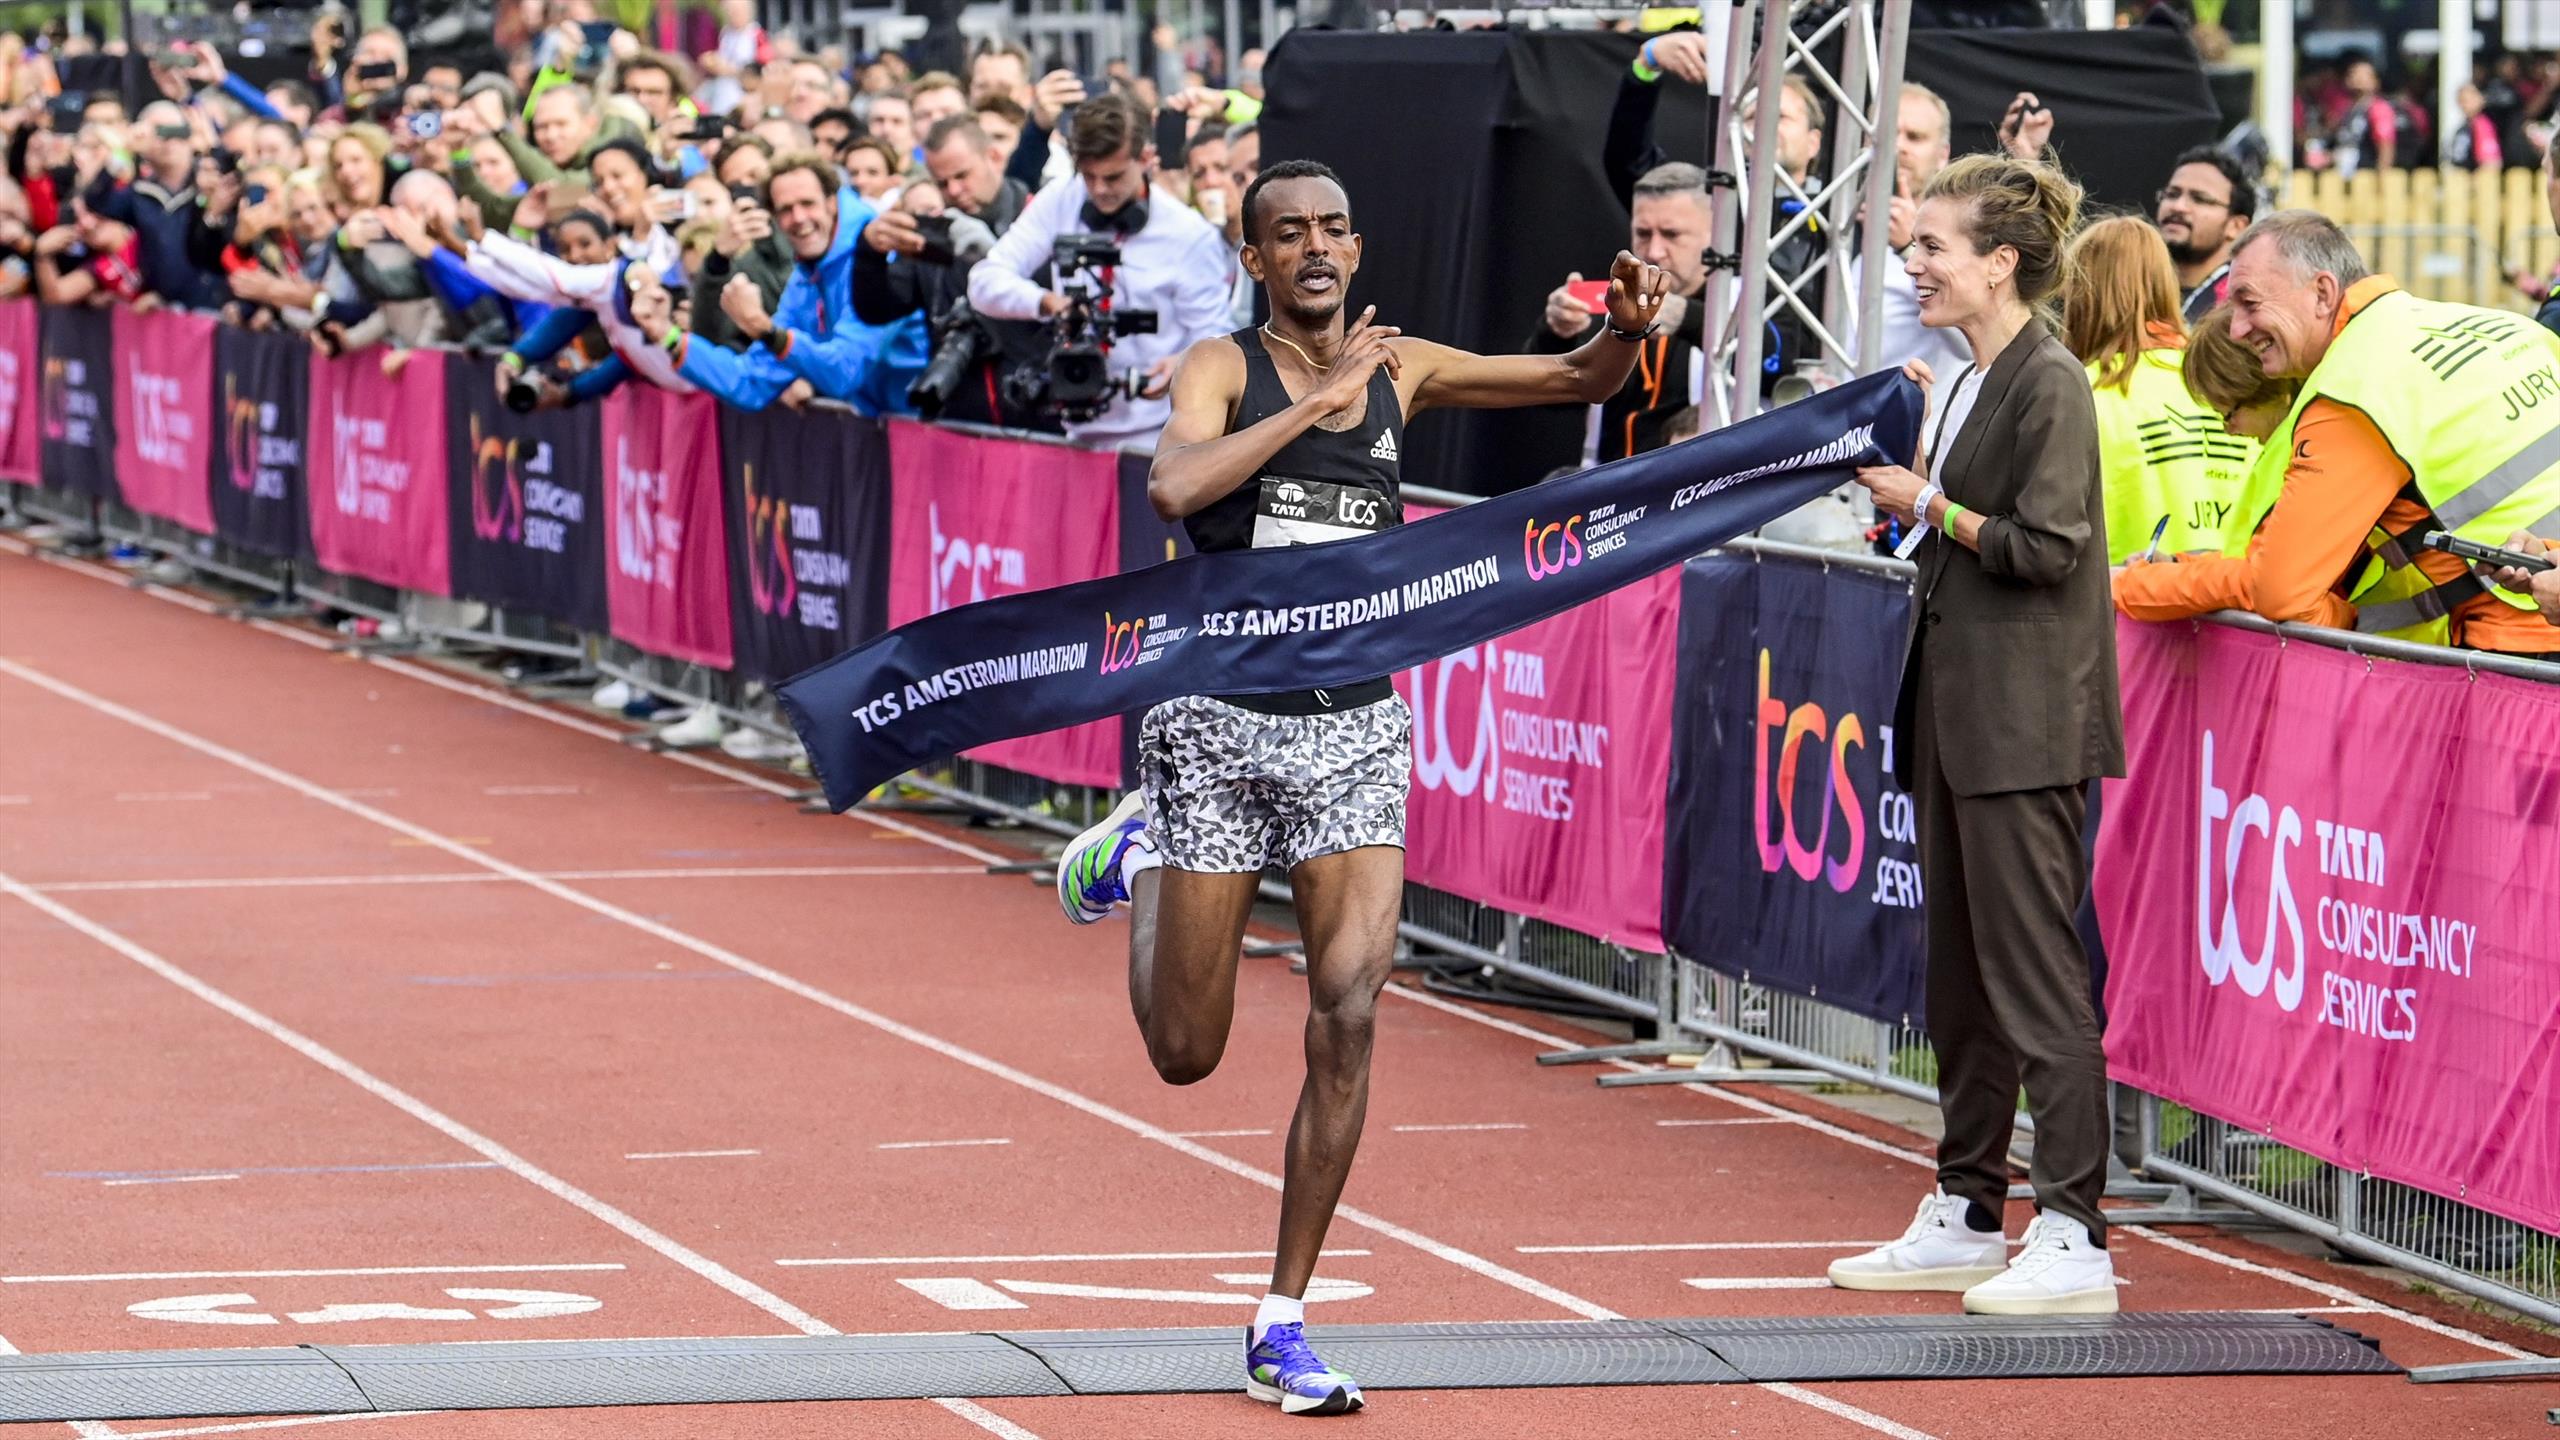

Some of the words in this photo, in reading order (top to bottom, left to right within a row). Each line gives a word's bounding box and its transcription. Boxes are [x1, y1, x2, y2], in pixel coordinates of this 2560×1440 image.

[2502, 364, 2560, 421] JURY
[1370, 447, 1398, 462] adidas
[1670, 482, 1702, 511] TCS
[1799, 422, 1874, 468] MARATHON
[1270, 502, 1306, 518] TATA
[1338, 491, 1379, 526] tcs
[1584, 505, 1648, 541] CONSULTANCY
[1588, 503, 1617, 523] TATA
[2188, 501, 2232, 529] JRY
[1524, 514, 1582, 581] tcs
[1587, 531, 1627, 560] SERVICES
[1148, 613, 1167, 631] TATA
[1241, 588, 1399, 636] AMSTERDAM
[1402, 555, 1500, 613] MARATHON
[1100, 611, 1145, 675] tcs
[1143, 626, 1188, 648] CONSULTANCY
[852, 693, 901, 733] TCS
[904, 654, 1018, 711] AMSTERDAM
[1020, 642, 1089, 678] MARATHON
[1502, 649, 1545, 699] TATA
[1502, 708, 1609, 769] CONSULTANC
[1502, 766, 1575, 822] SERVICES
[1755, 648, 1865, 892] tcs
[2199, 729, 2304, 1012] tcs
[2315, 819, 2385, 887] TATA
[2317, 896, 2476, 979] CONSULTANCY
